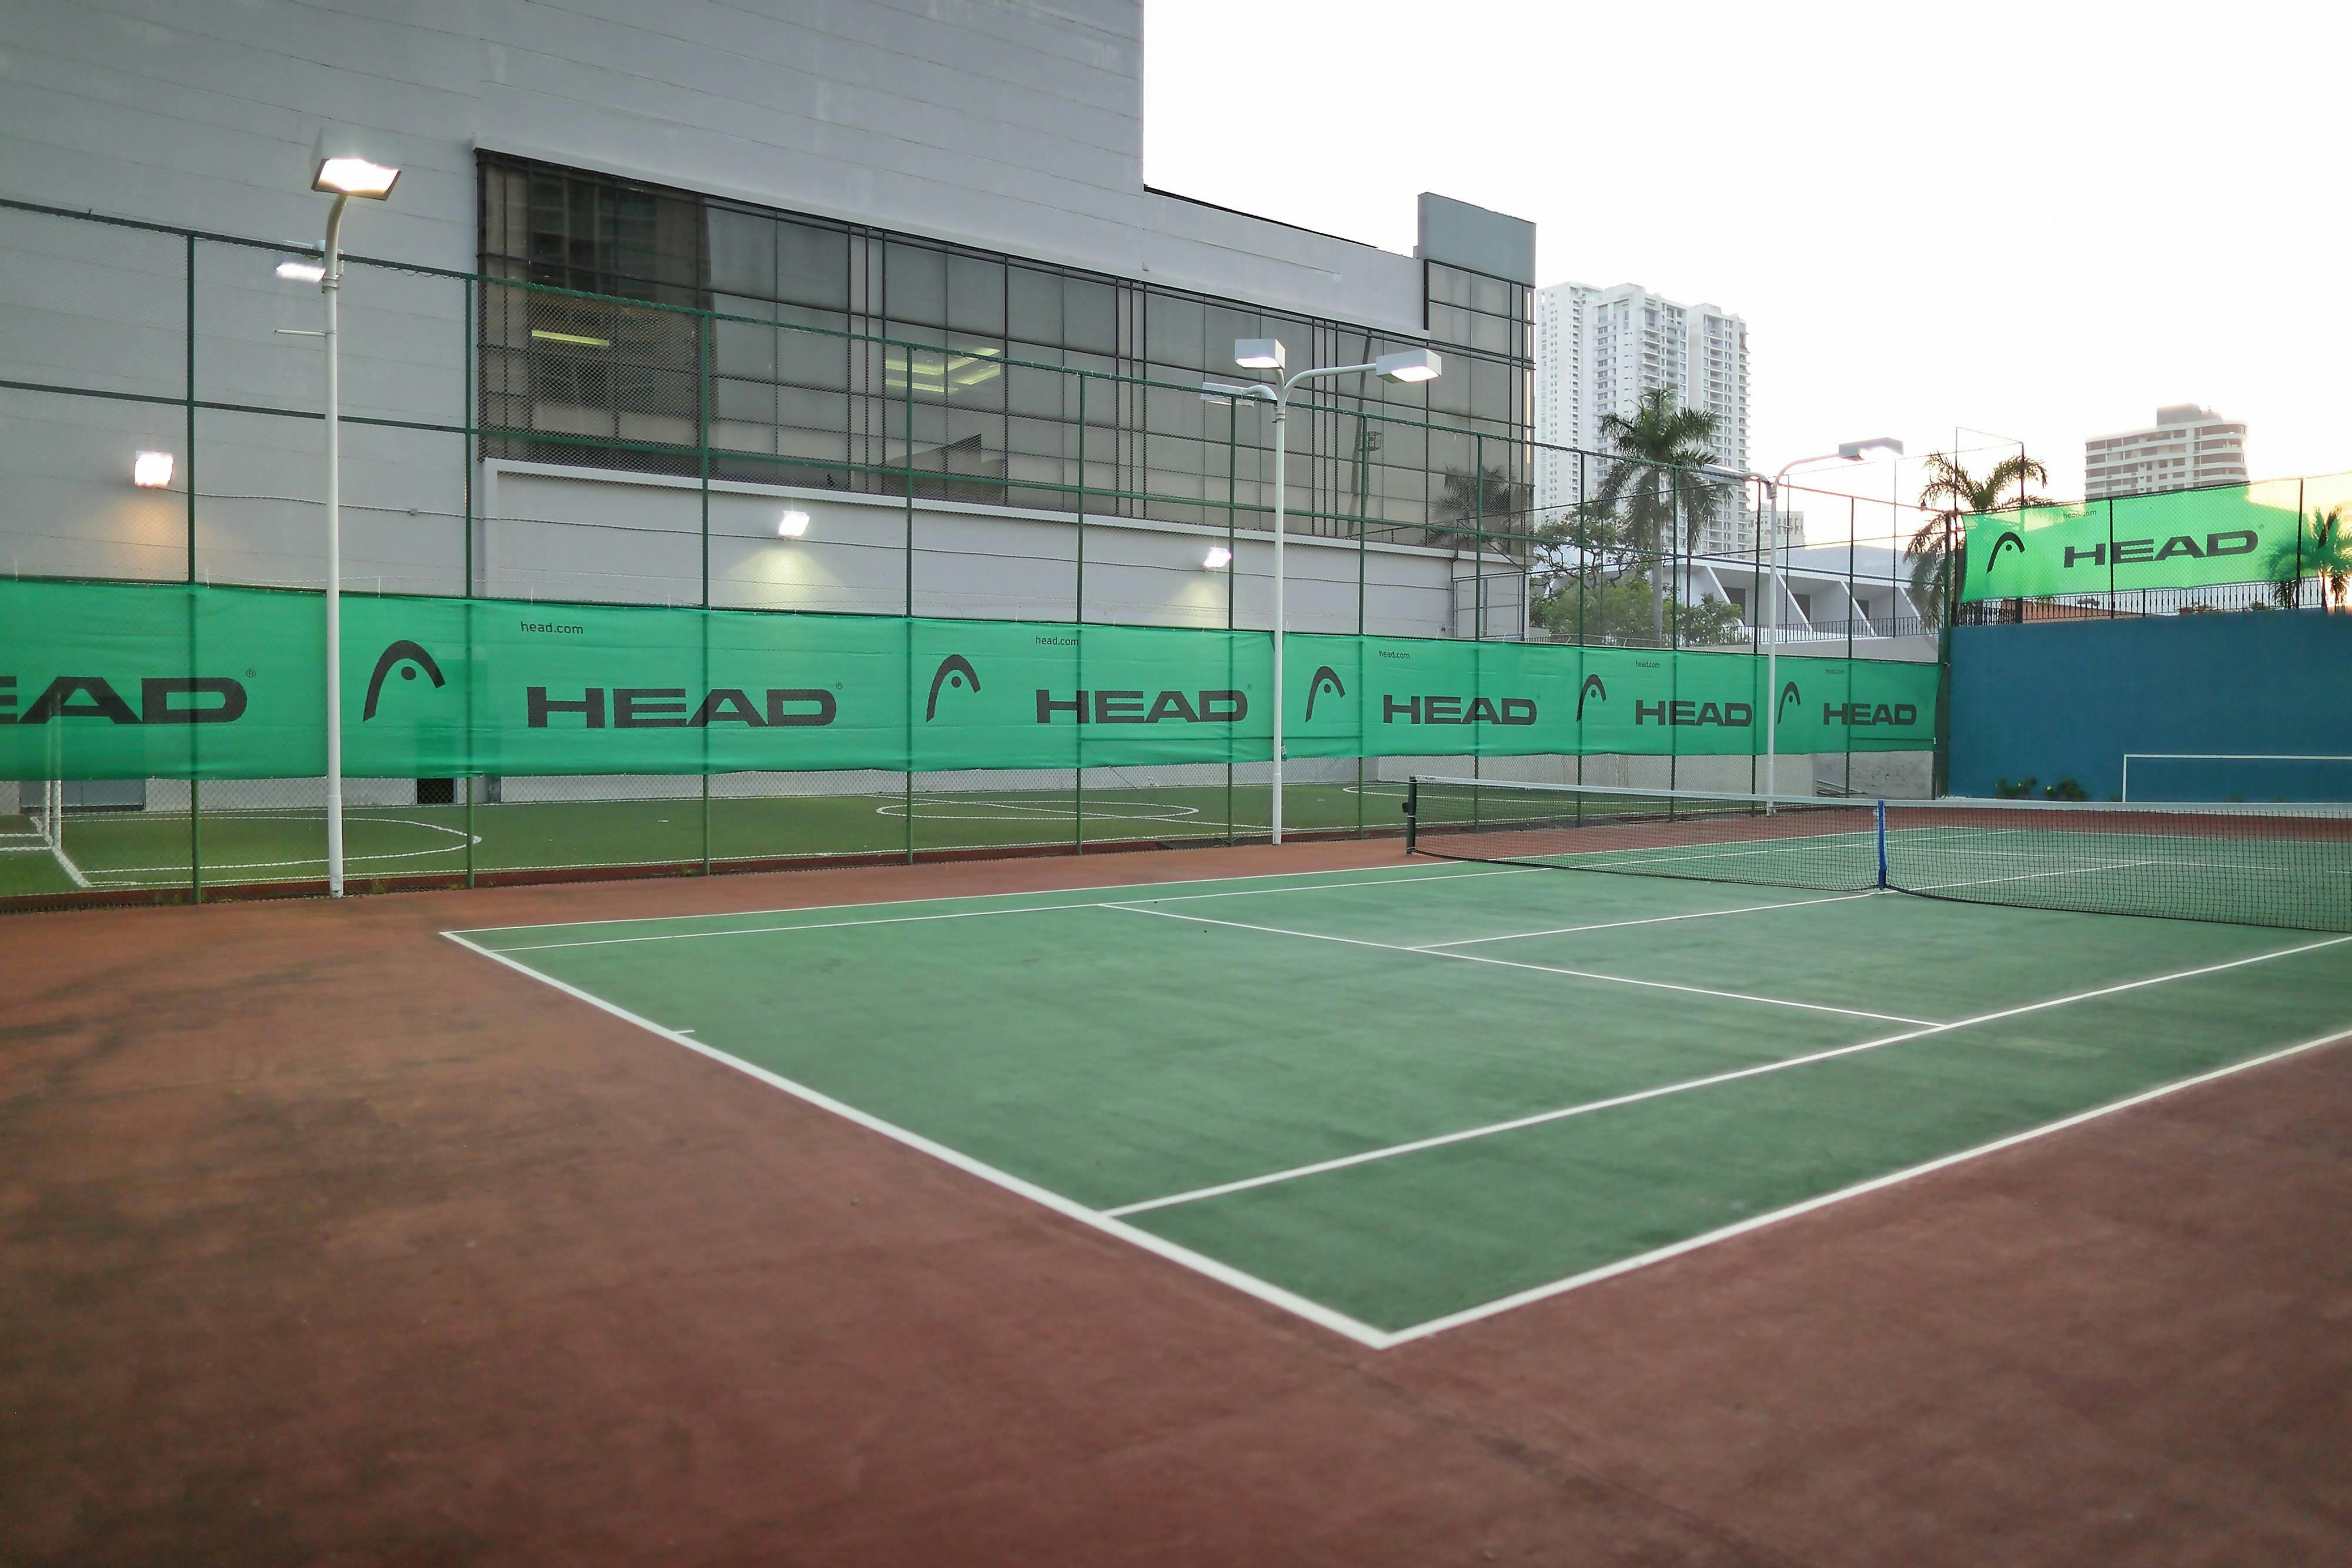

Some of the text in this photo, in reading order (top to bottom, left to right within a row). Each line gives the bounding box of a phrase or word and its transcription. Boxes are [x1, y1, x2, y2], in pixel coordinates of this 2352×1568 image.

[2064, 530, 2259, 568] HEAD
[520, 621, 583, 634] head.com
[1035, 636, 1078, 646] head.com
[1379, 650, 1410, 658] head.com
[0, 676, 247, 724] AD
[527, 687, 837, 728] HEAD
[1036, 689, 1248, 723] HEAD
[1383, 694, 1536, 725] HEAD
[1635, 700, 1752, 727] HEAD
[1823, 703, 1916, 725] HEAD
